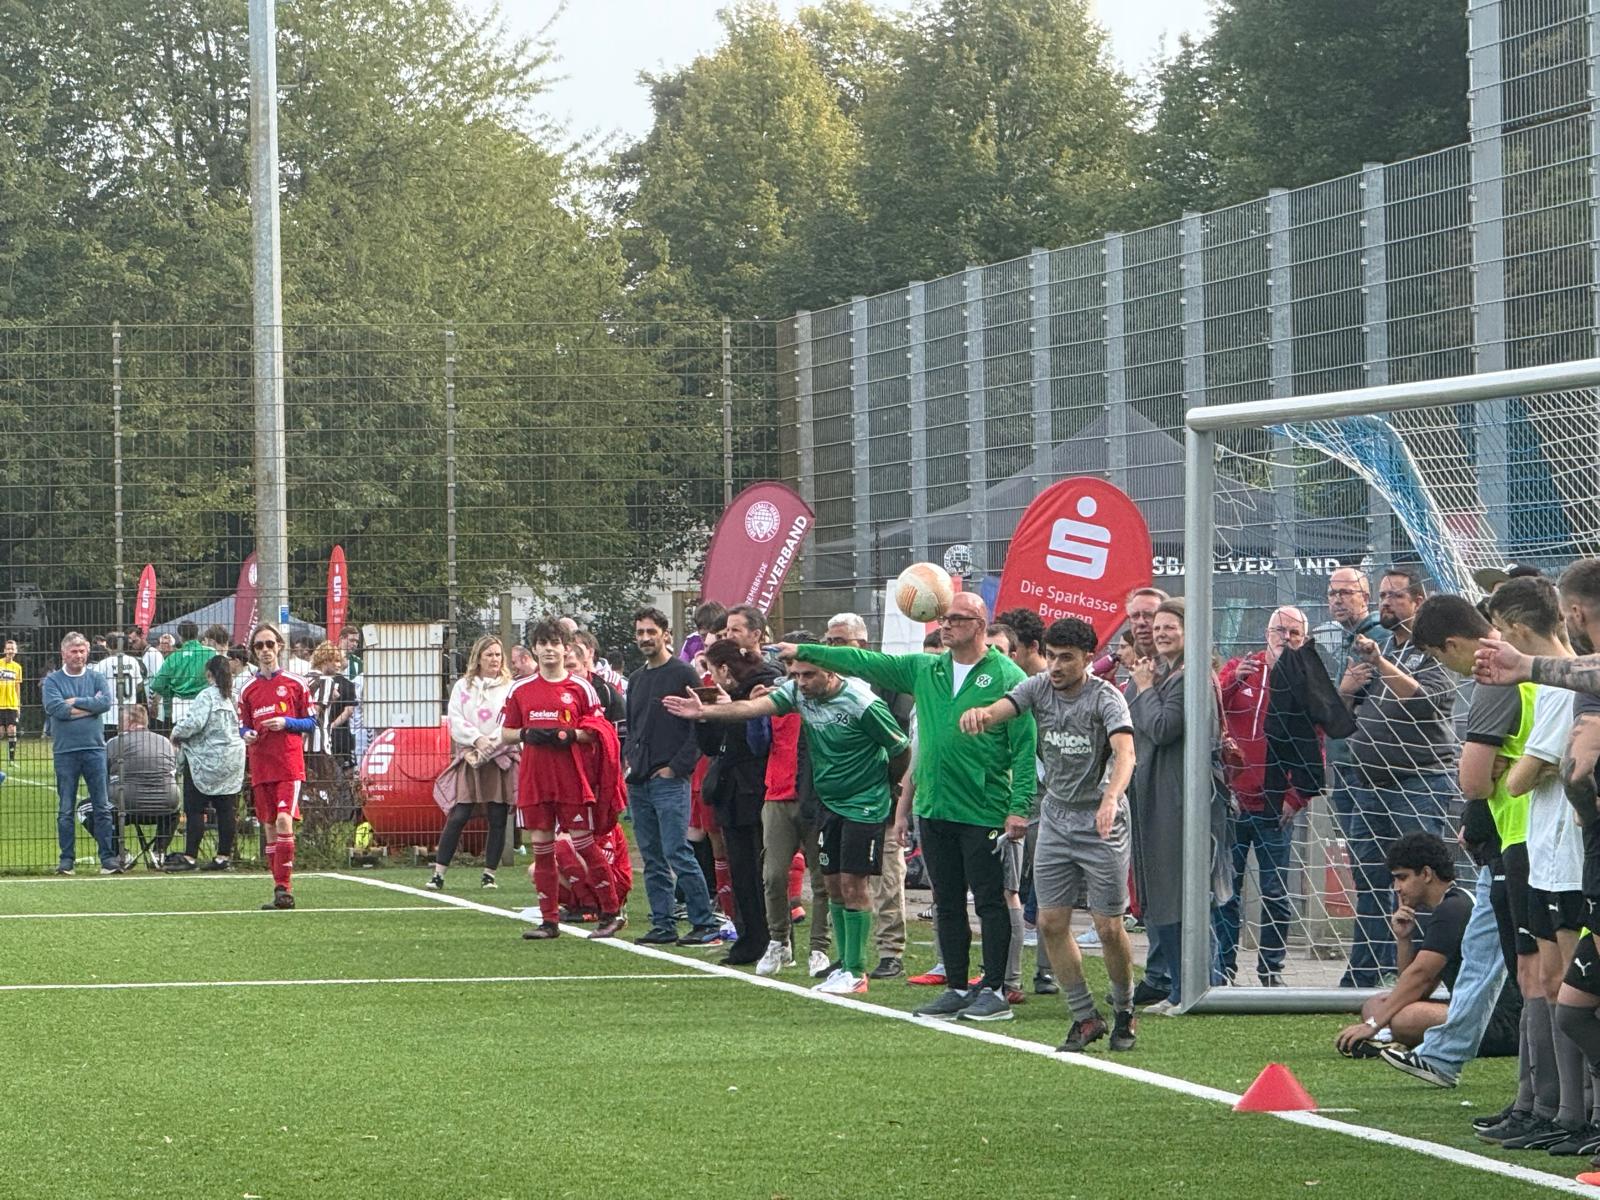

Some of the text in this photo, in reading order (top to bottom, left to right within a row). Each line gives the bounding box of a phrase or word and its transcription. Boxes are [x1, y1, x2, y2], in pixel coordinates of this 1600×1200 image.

[1020, 580, 1118, 613] Die Sparkasse
[530, 710, 559, 718] Seeland
[836, 712, 849, 724] 96
[817, 831, 824, 848] 4
